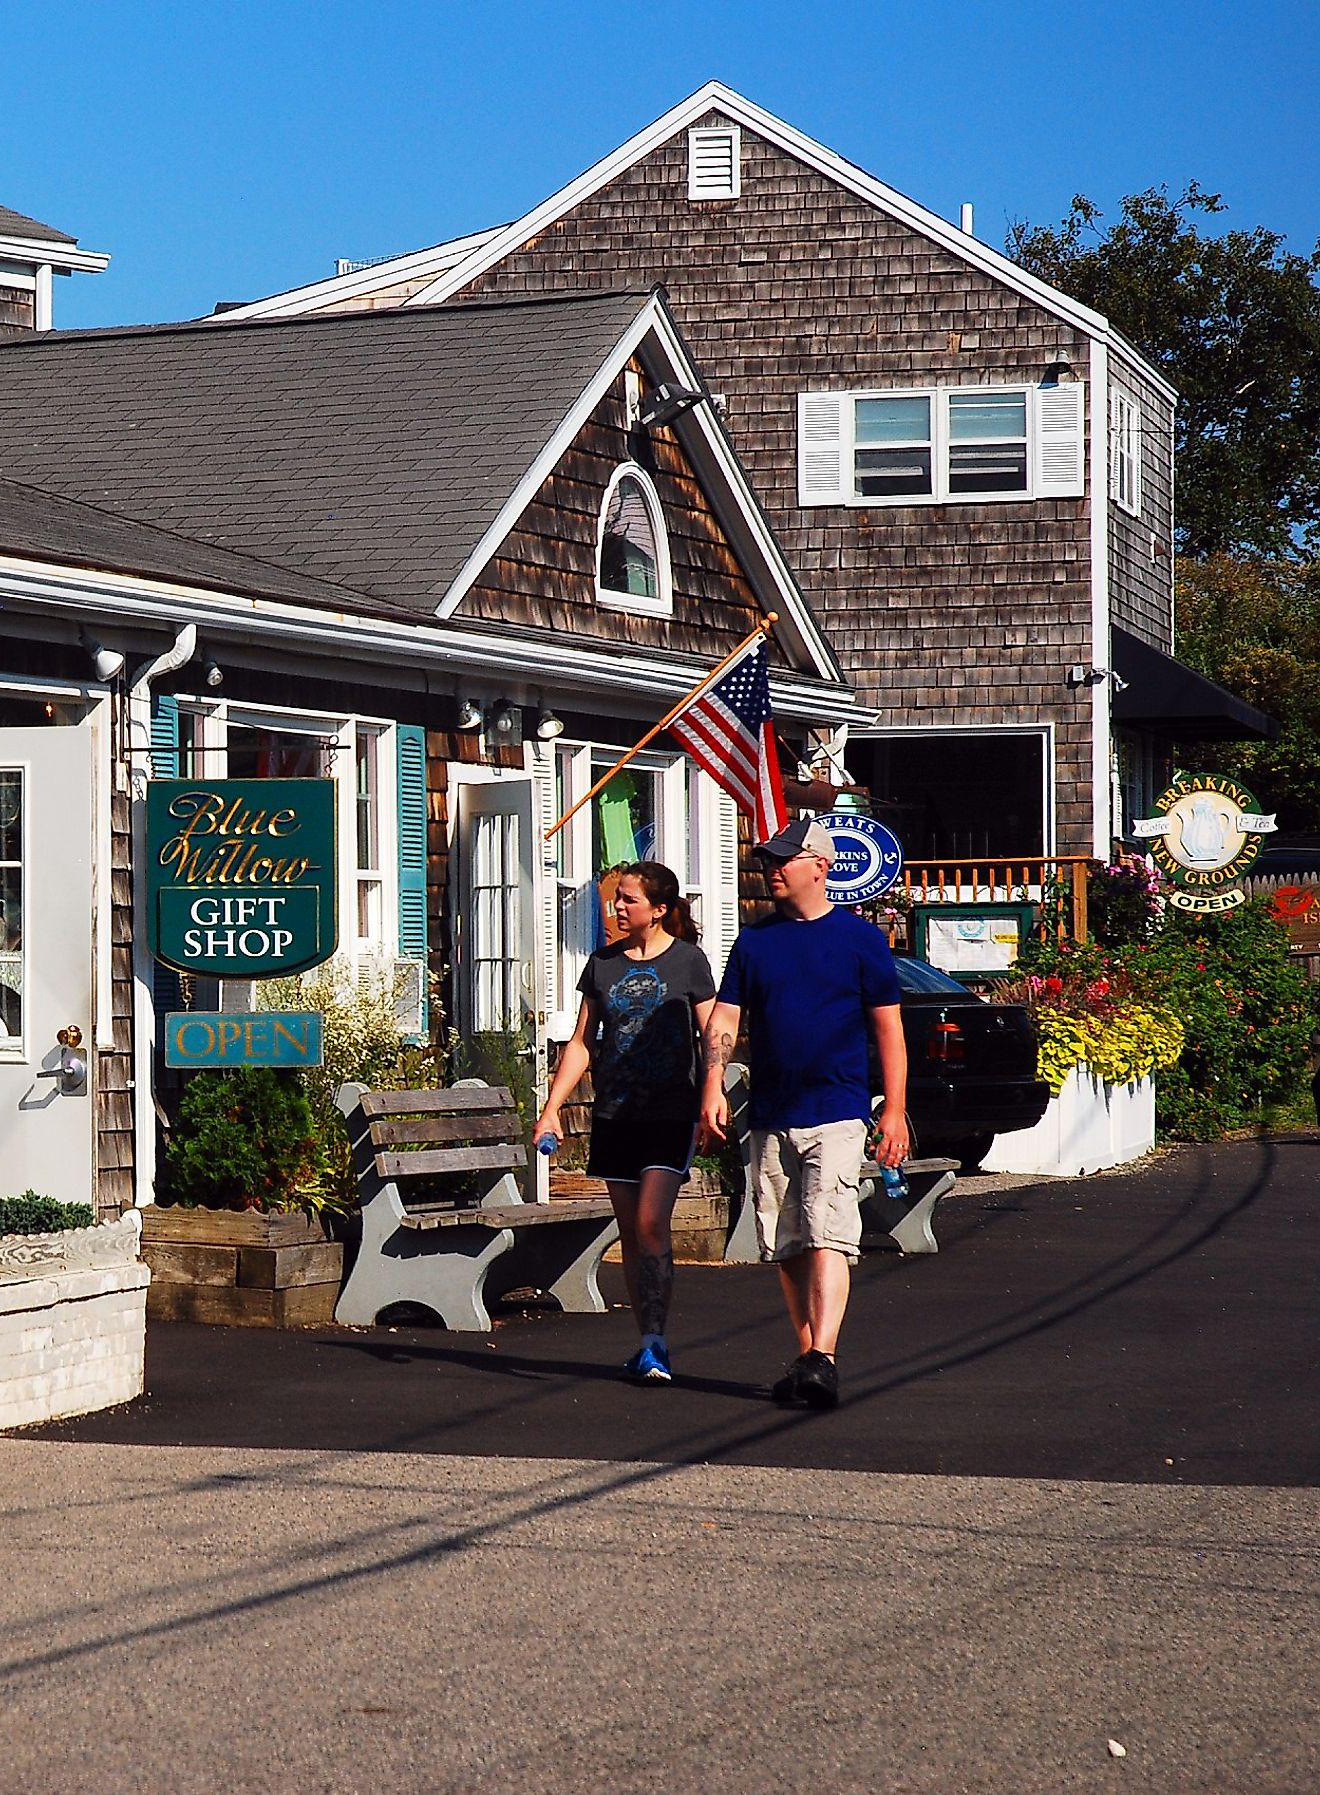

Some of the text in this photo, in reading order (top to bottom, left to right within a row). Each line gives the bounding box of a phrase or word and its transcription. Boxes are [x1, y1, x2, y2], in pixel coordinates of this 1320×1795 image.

[1155, 776, 1252, 812] BREAKING
[169, 791, 302, 839] Blue
[818, 816, 875, 834] WEATS
[1252, 817, 1270, 828] Tea
[160, 837, 322, 884] Willow
[828, 862, 858, 872] OVE
[834, 851, 868, 861] RKINS
[1149, 834, 1262, 885] NEW GROUNDS
[846, 890, 859, 900] IN
[860, 873, 889, 897] TOWN
[190, 897, 286, 926] GIFT
[1177, 894, 1238, 909] OPEN
[183, 929, 293, 957] SHOP
[176, 1020, 310, 1058] OPEN
